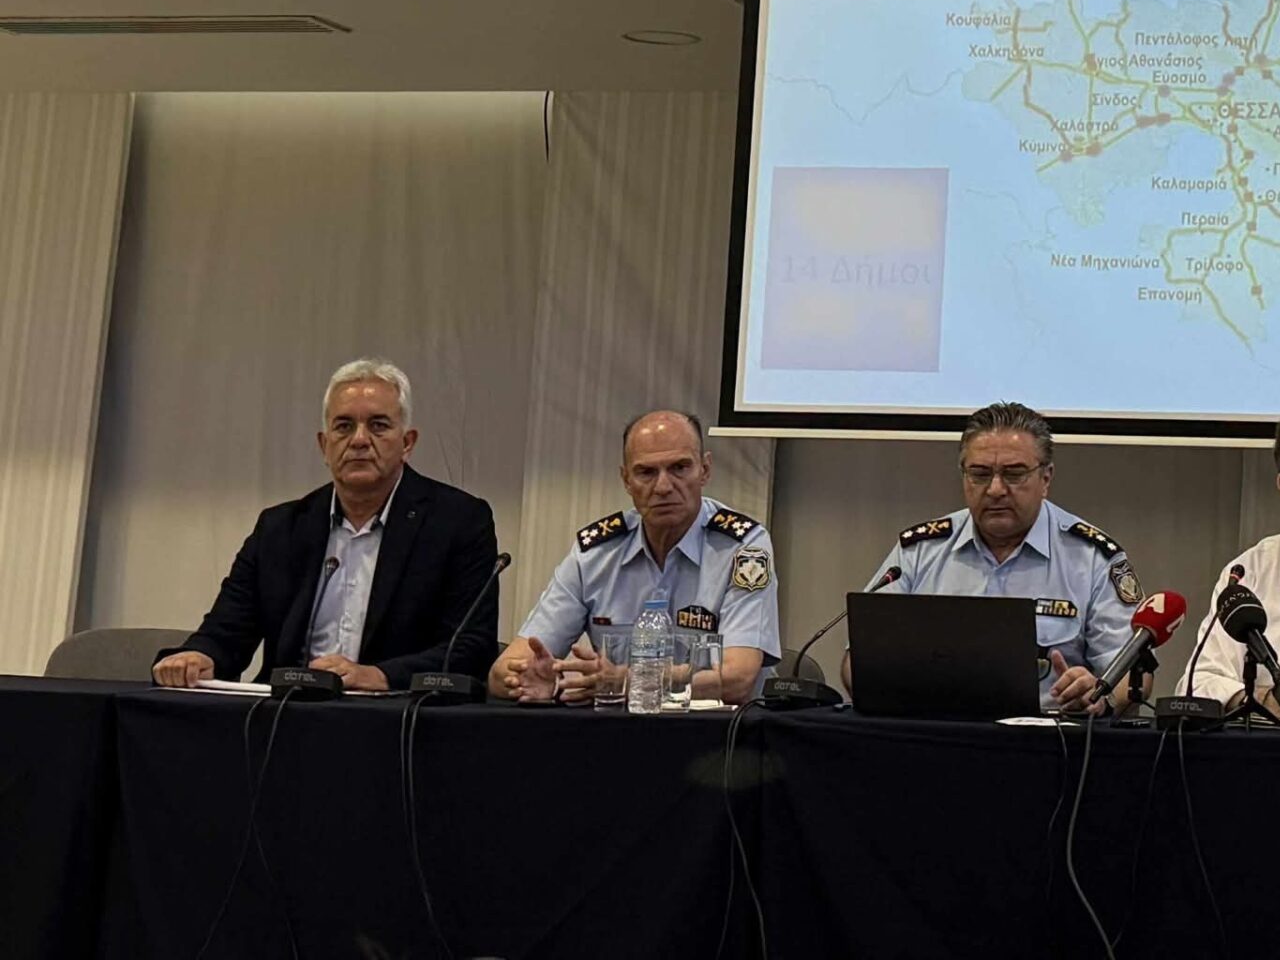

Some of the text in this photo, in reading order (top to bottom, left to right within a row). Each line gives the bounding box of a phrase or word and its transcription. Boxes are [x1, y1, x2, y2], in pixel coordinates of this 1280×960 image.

[1135, 32, 1219, 48] Πεντάλοφος
[1129, 52, 1203, 70] Αθανάσιος
[1151, 176, 1228, 192] Καλαμαριά
[1182, 212, 1229, 227] Περαία
[1051, 254, 1160, 271] Νέα Μηχανιώνα
[1186, 256, 1244, 274] Τρίλοφο
[1138, 286, 1203, 304] Επανομή
